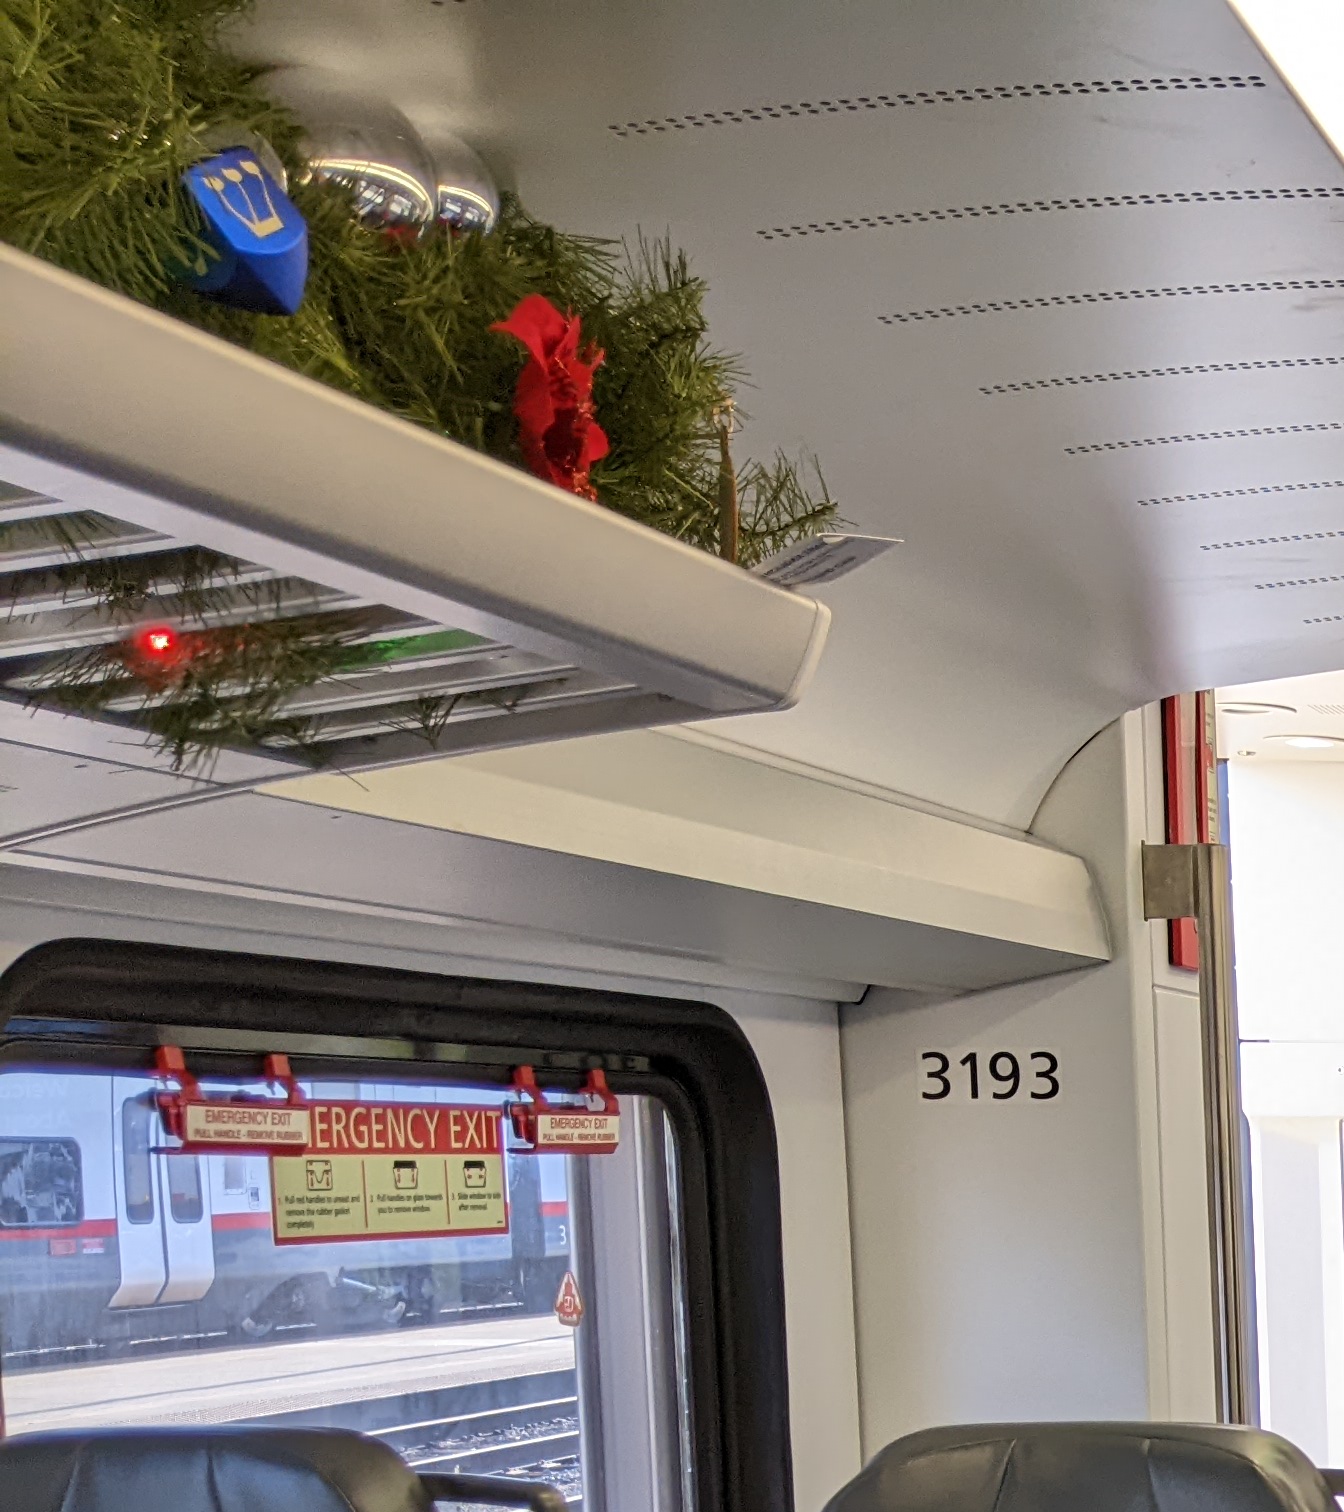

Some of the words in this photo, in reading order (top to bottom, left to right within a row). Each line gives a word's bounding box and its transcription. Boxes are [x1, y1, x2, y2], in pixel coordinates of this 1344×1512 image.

[921, 1051, 1060, 1100] 3193
[205, 1109, 269, 1125] EMERGENCY
[271, 1111, 292, 1126] EXIT
[307, 1106, 440, 1149] ERGENCY
[450, 1110, 501, 1149] EXIT
[550, 1117, 593, 1129] EMERGENCY
[594, 1118, 608, 1129] EXIT
[559, 1225, 567, 1245] 3
